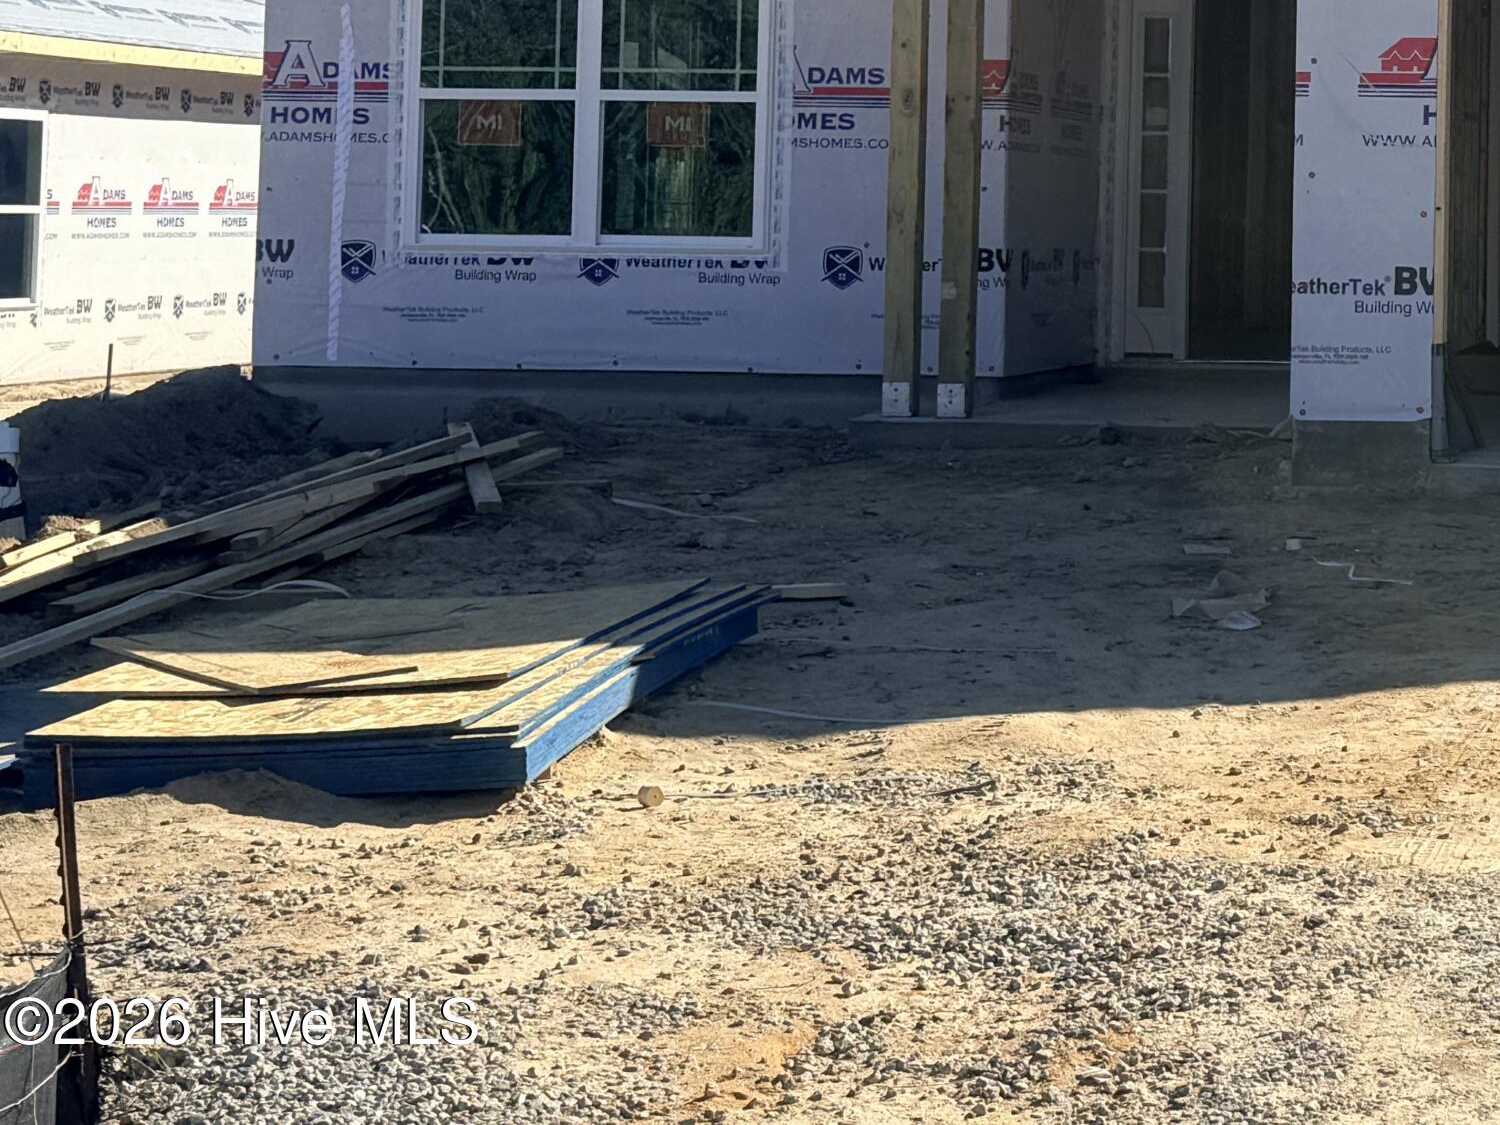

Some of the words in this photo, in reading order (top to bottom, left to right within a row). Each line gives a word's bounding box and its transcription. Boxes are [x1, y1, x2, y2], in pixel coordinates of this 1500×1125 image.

[270, 106, 370, 125] HOMS
[476, 115, 501, 130] MI
[664, 115, 692, 132] MI
[792, 113, 856, 131] MES
[262, 267, 294, 279] Wrap
[455, 269, 502, 283] Building
[505, 269, 537, 283] Wrap
[698, 272, 745, 286] Building
[748, 273, 781, 287] Wrap
[76, 298, 93, 315] BW
[147, 295, 163, 311] BW
[213, 292, 228, 307] BW
[1354, 300, 1412, 317] Building
